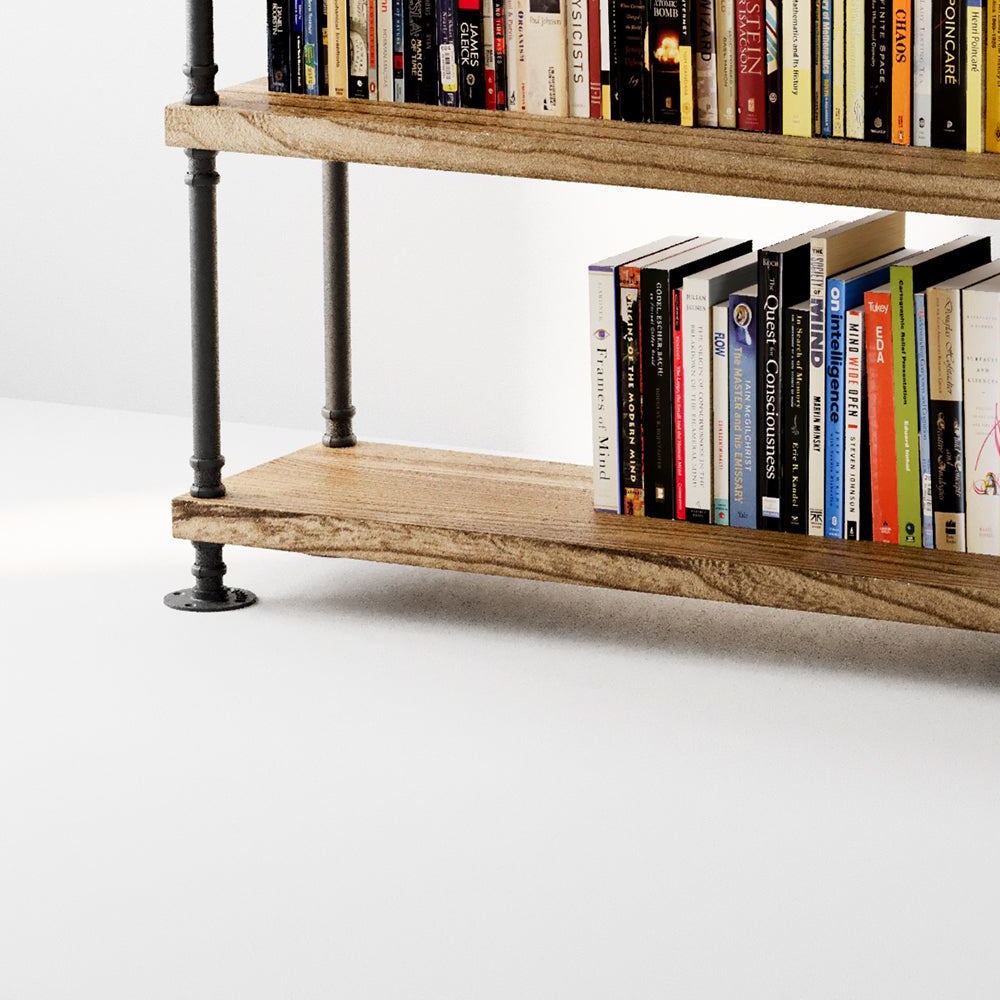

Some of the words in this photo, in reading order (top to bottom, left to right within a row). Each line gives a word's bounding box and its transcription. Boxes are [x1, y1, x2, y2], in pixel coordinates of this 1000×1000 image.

[411, 39, 416, 50] OF
[461, 23, 470, 66] GLEICK
[470, 24, 479, 66] JAMES
[739, 10, 748, 74] ISAACSON
[896, 10, 906, 63] CHAOS
[764, 295, 778, 344] Quest
[831, 287, 840, 311] on
[715, 332, 725, 357] FLOW
[811, 299, 822, 367] MIND
[849, 324, 859, 352] MIND
[596, 349, 608, 410] Frames
[828, 315, 843, 423] intelligence
[848, 358, 859, 385] WIDE
[598, 417, 607, 429] of
[765, 359, 778, 479] Consciousness
[813, 396, 821, 423] MARVIN
[848, 390, 858, 416] OPEN
[599, 436, 610, 480] Mind
